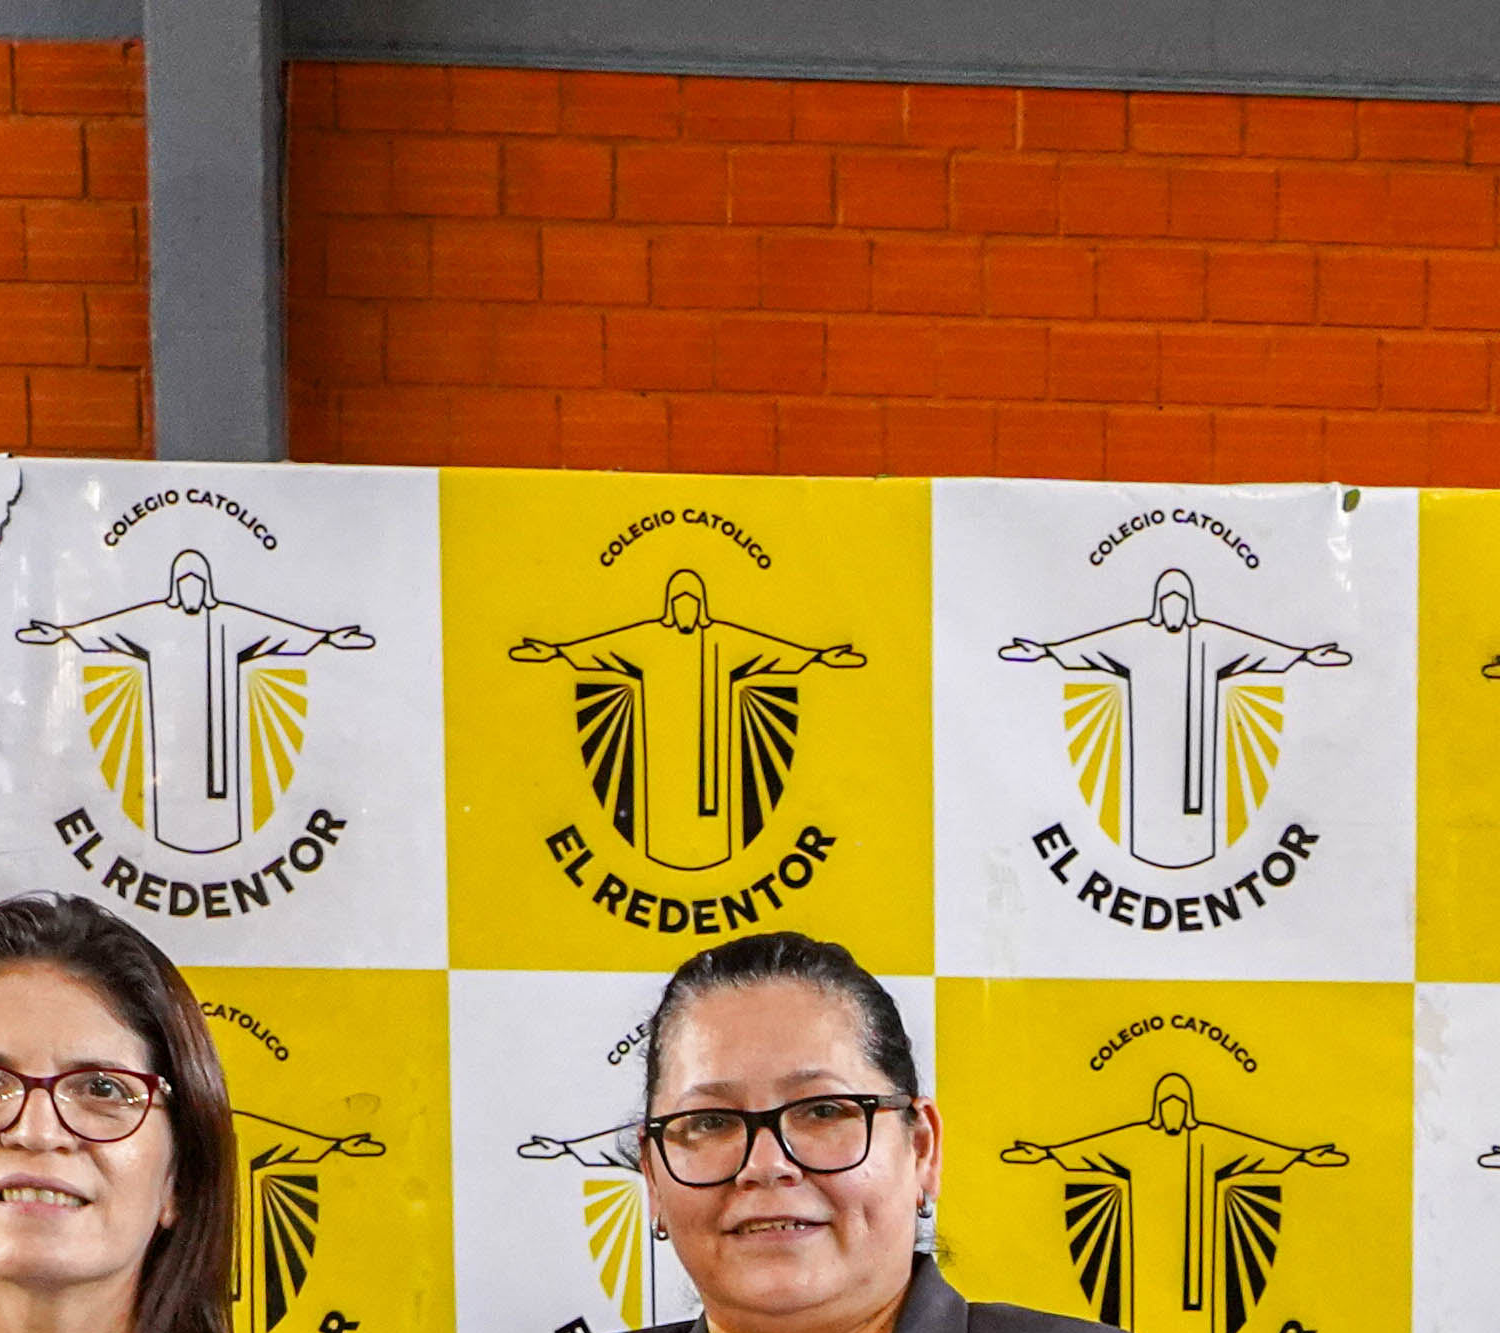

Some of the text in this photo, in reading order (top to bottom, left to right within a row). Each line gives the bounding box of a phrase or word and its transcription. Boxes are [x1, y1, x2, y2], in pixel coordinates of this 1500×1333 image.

[104, 488, 278, 551] COLEGIO CATOLICO
[600, 508, 772, 570] COLEGIO CATOLICO
[1089, 508, 1260, 570] COLEGIO CATOLICO
[53, 807, 347, 919] EL REDENTOR
[545, 824, 837, 935] EL REDENTOR
[1032, 823, 1320, 932] EL REDENTOR
[201, 1001, 289, 1062] CATOLICO
[1089, 1014, 1258, 1073] COLEGIO CATOLICO
